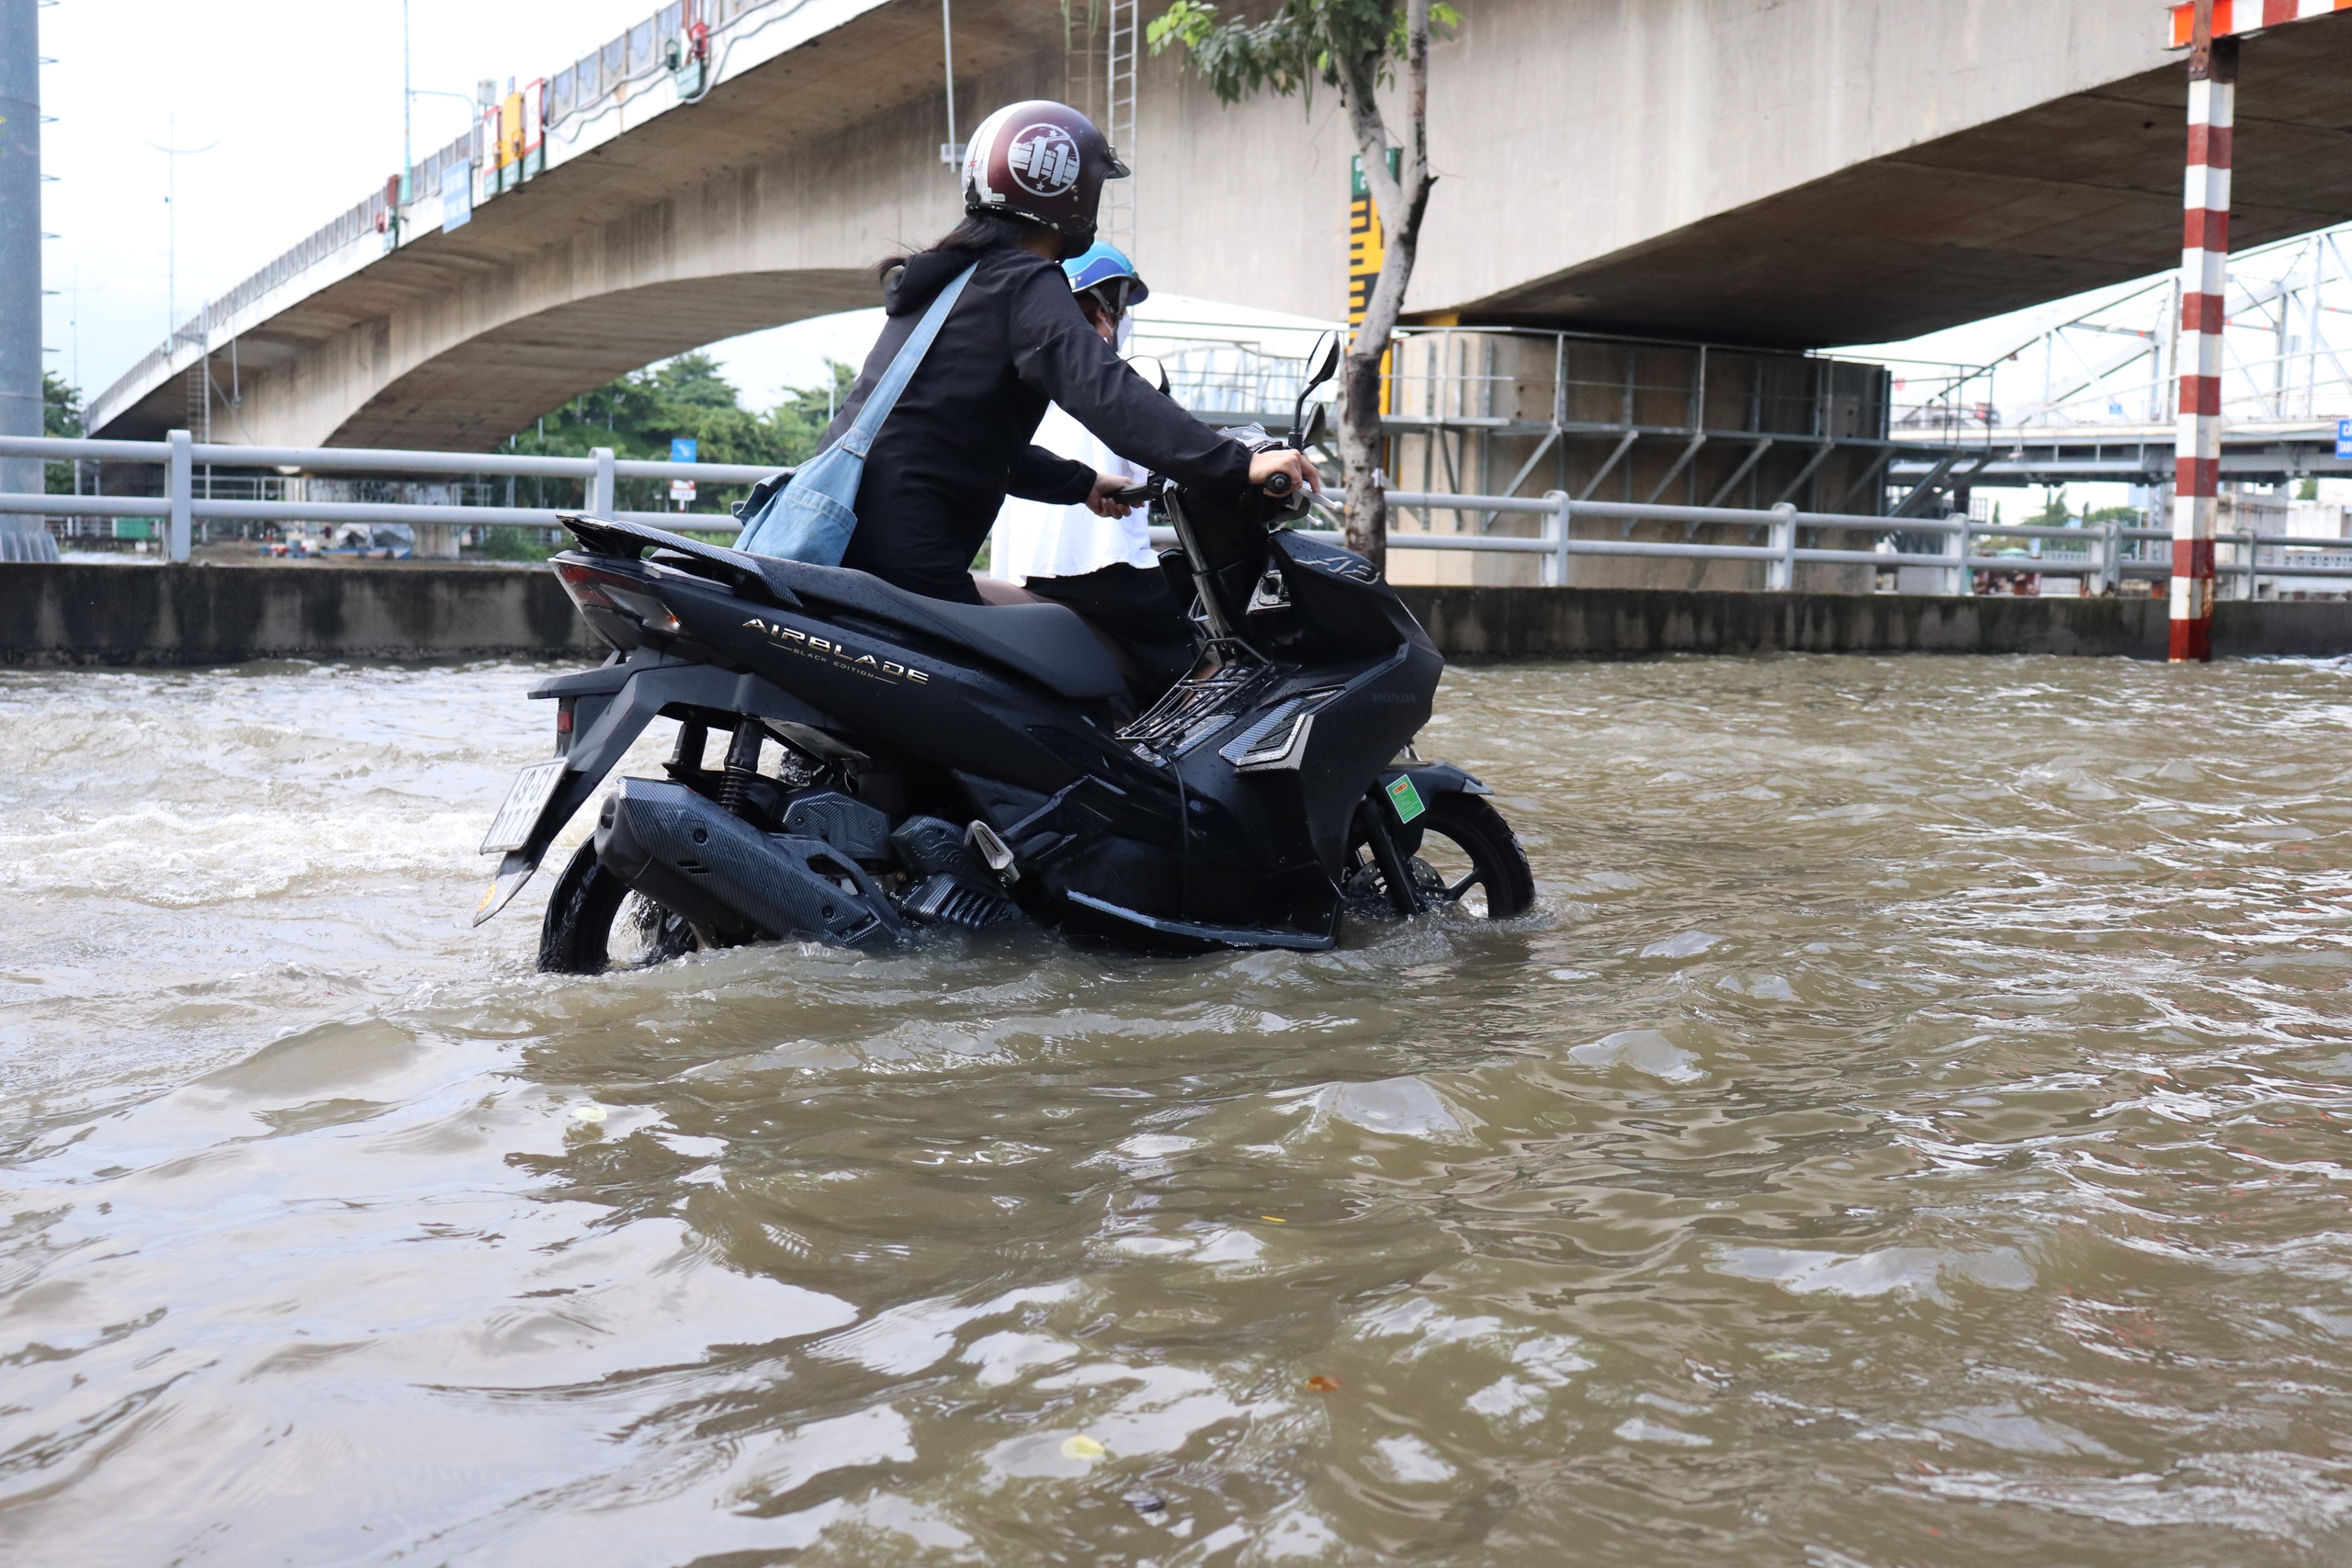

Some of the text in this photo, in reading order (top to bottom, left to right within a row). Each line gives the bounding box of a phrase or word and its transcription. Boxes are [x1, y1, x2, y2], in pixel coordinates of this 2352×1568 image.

[742, 618, 930, 685] AIRBLADE
[793, 649, 875, 679] BLACK EDITION
[1372, 693, 1417, 704] HONDA
